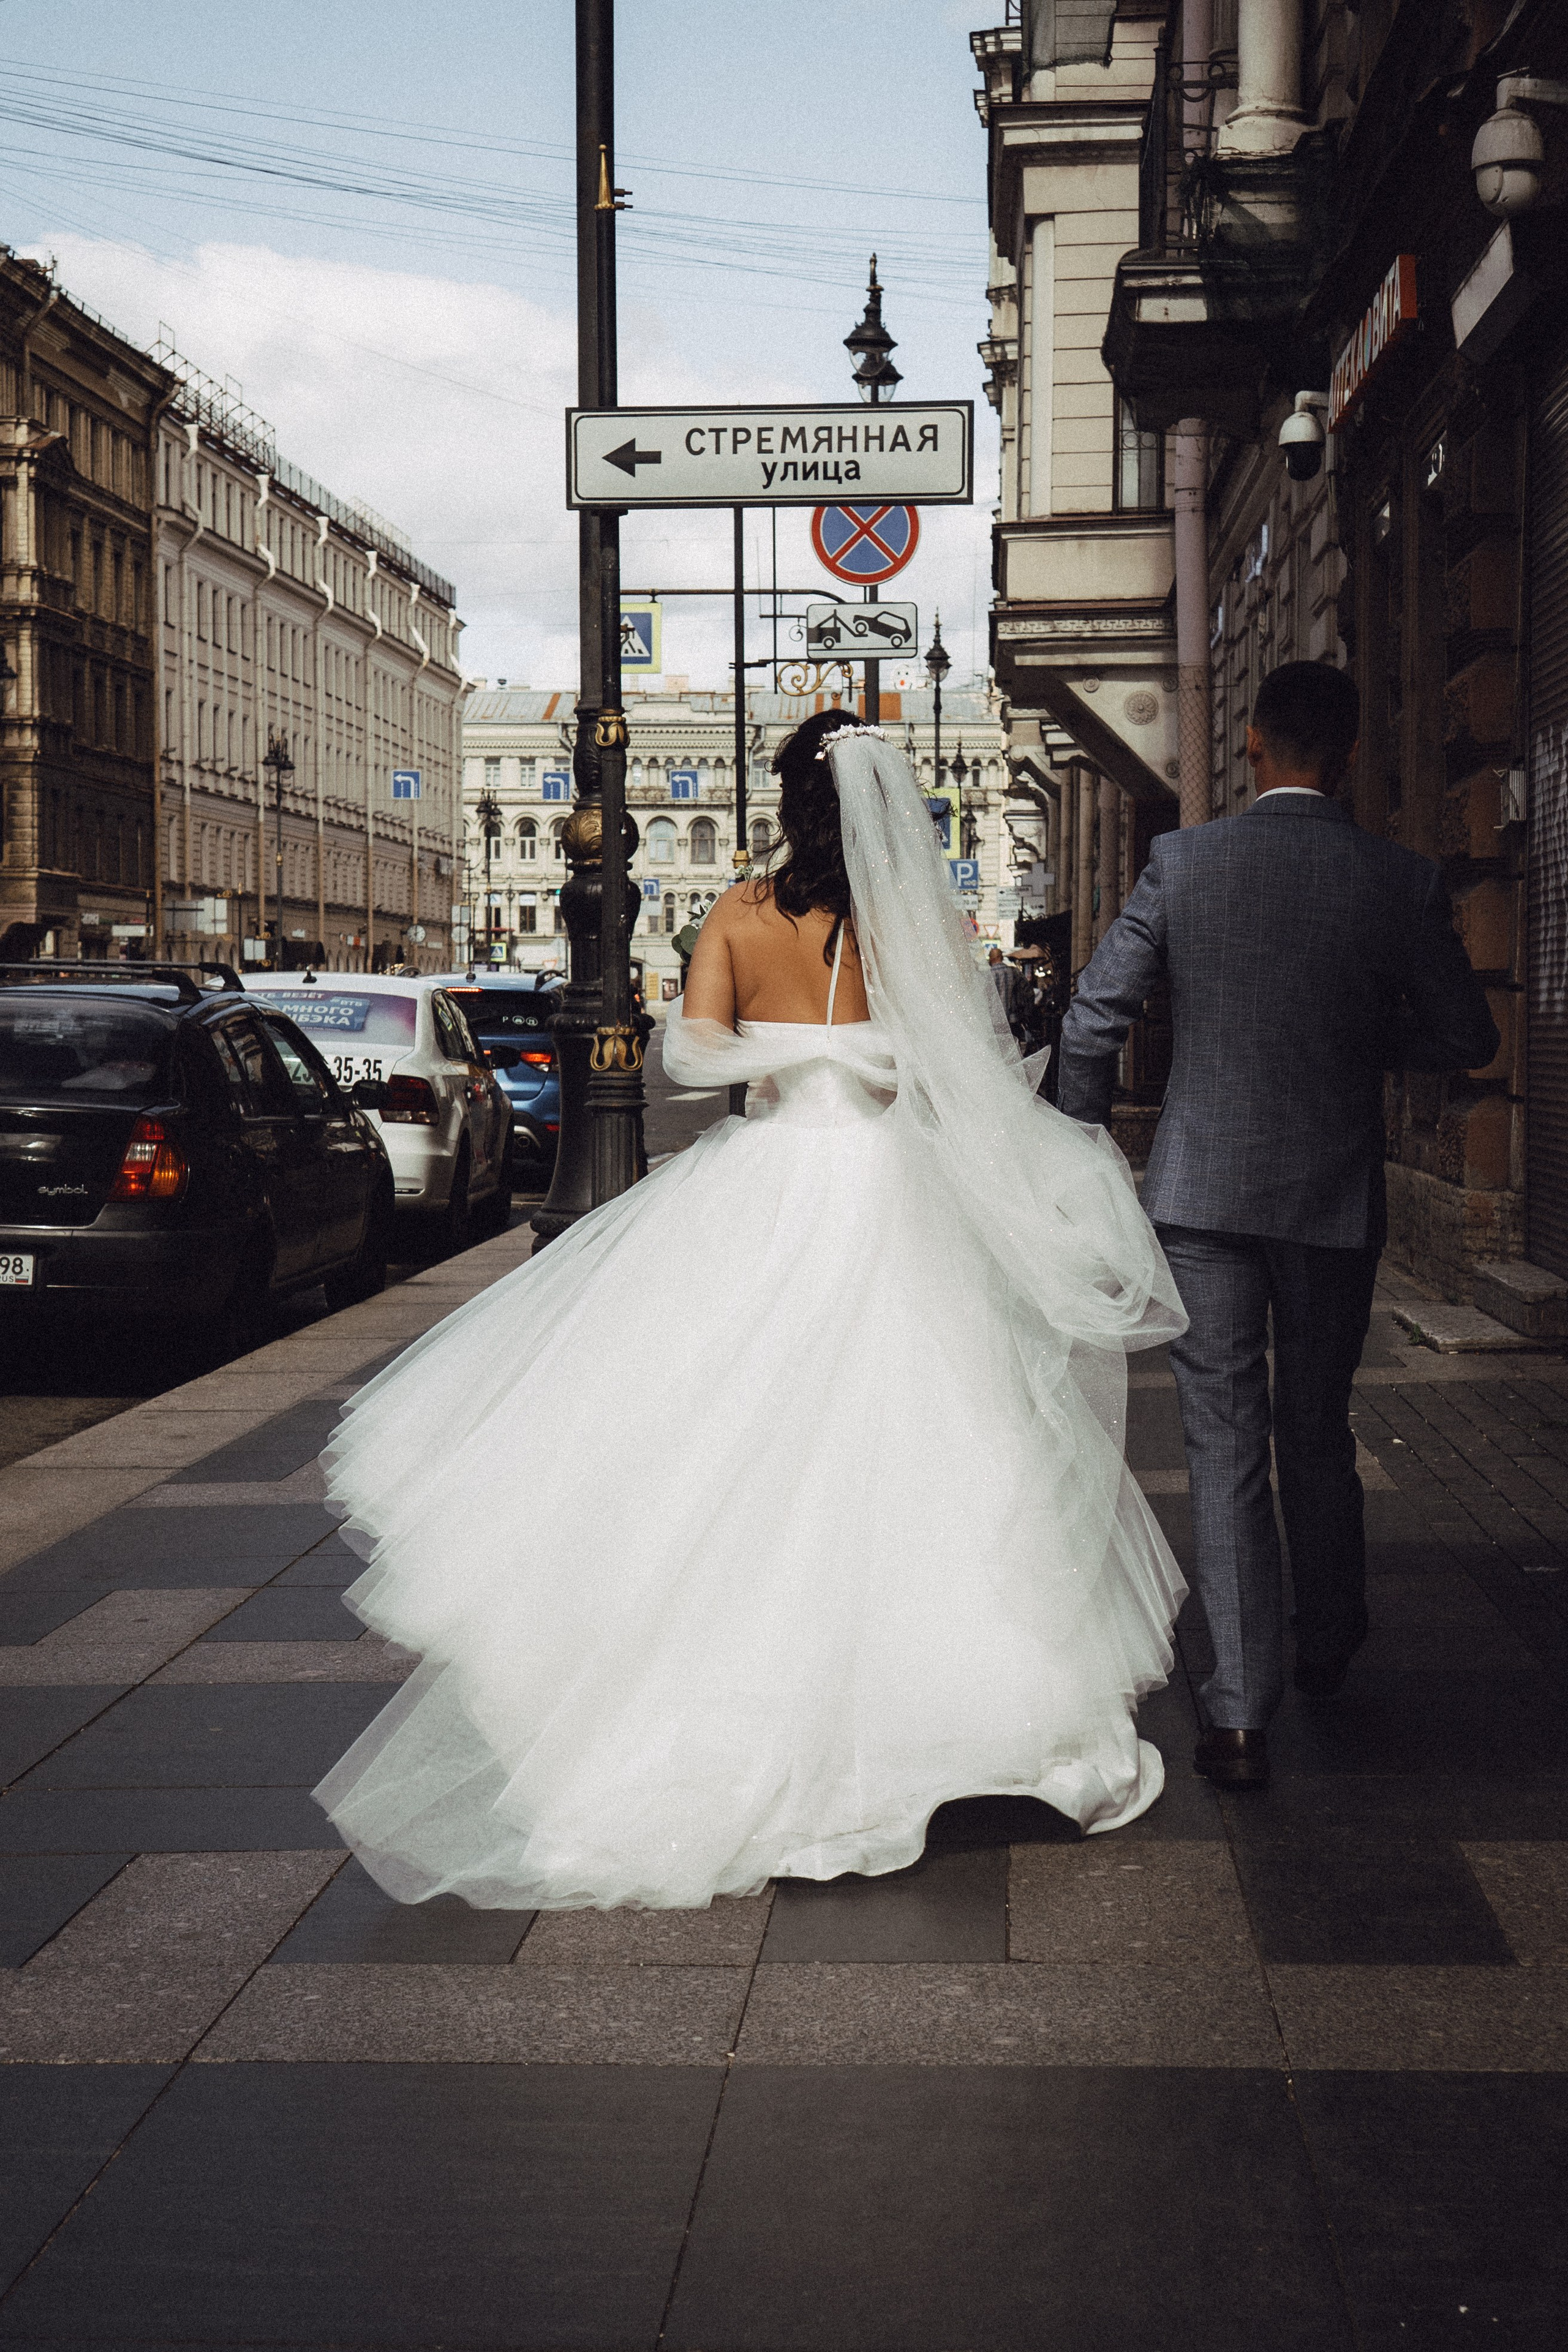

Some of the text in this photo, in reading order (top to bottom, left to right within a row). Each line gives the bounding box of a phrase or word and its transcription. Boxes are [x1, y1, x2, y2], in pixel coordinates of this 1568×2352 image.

[1328, 255, 1401, 432] АПТЕКА ВИТА
[684, 424, 939, 456] СТРЕМЯННАЯ
[761, 458, 861, 489] улица
[281, 1004, 354, 1016] МНОГО
